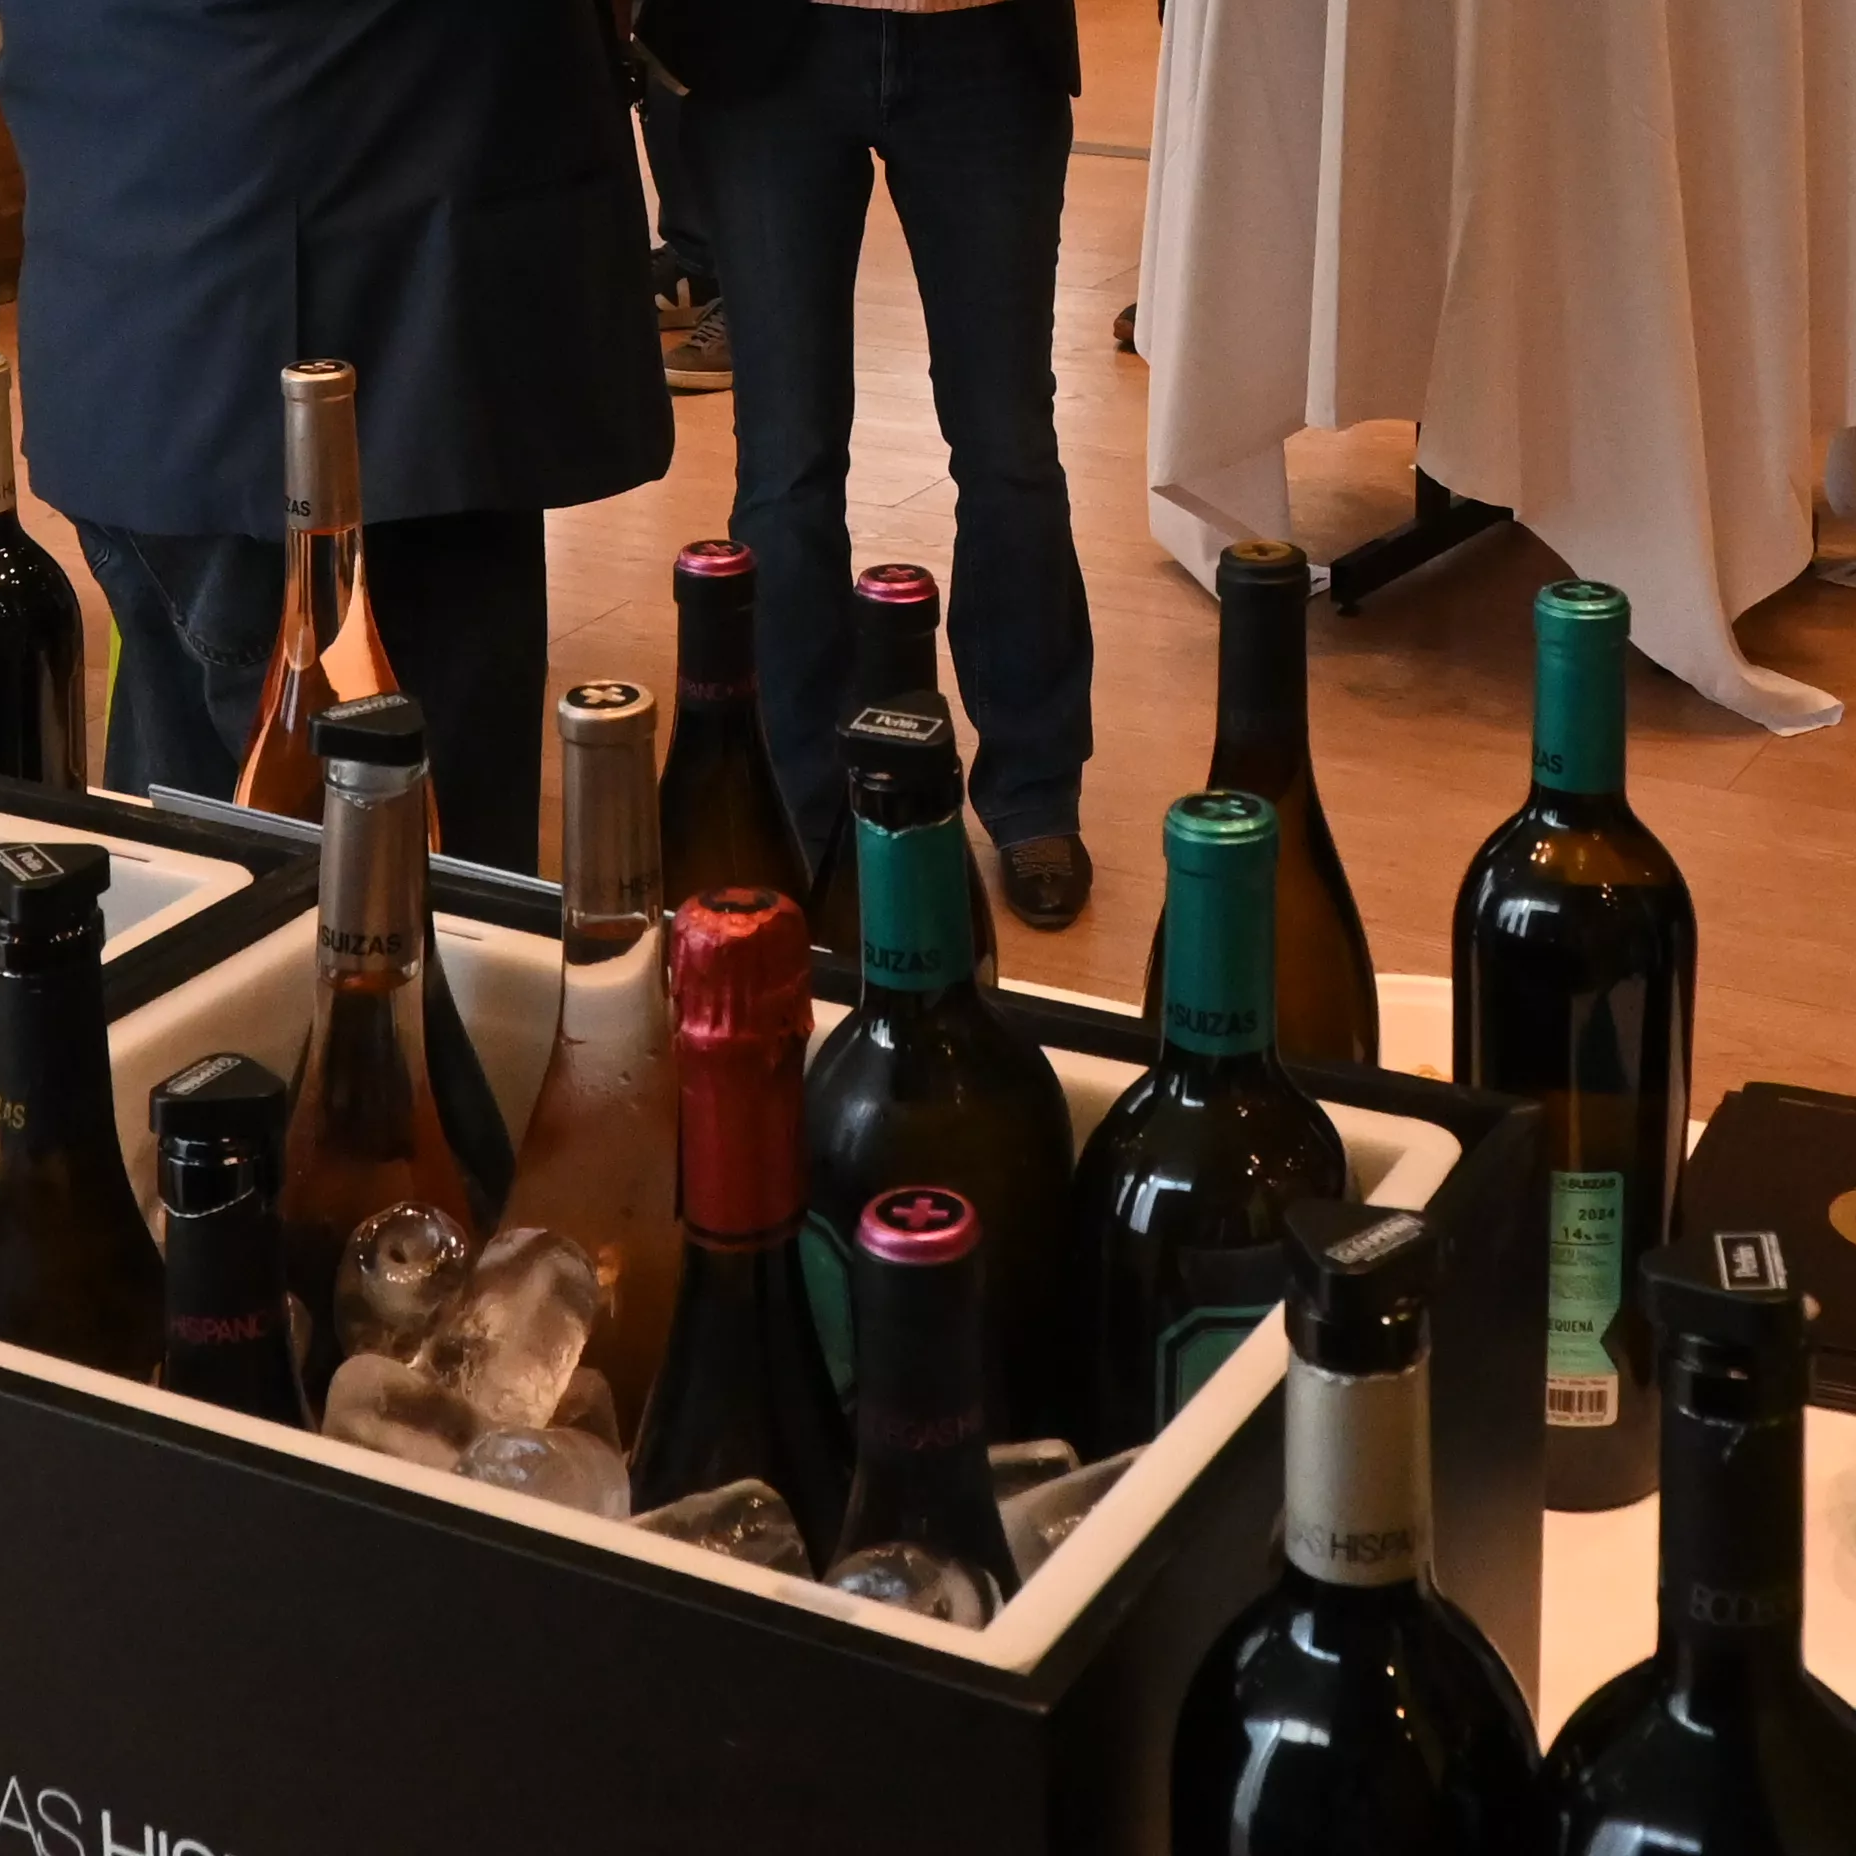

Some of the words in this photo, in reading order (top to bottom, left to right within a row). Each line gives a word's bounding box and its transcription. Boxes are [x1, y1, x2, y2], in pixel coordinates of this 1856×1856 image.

[321, 925, 402, 955] SUIZAS
[864, 941, 944, 973] SUIZAS
[1174, 1004, 1258, 1037] SUIZAS
